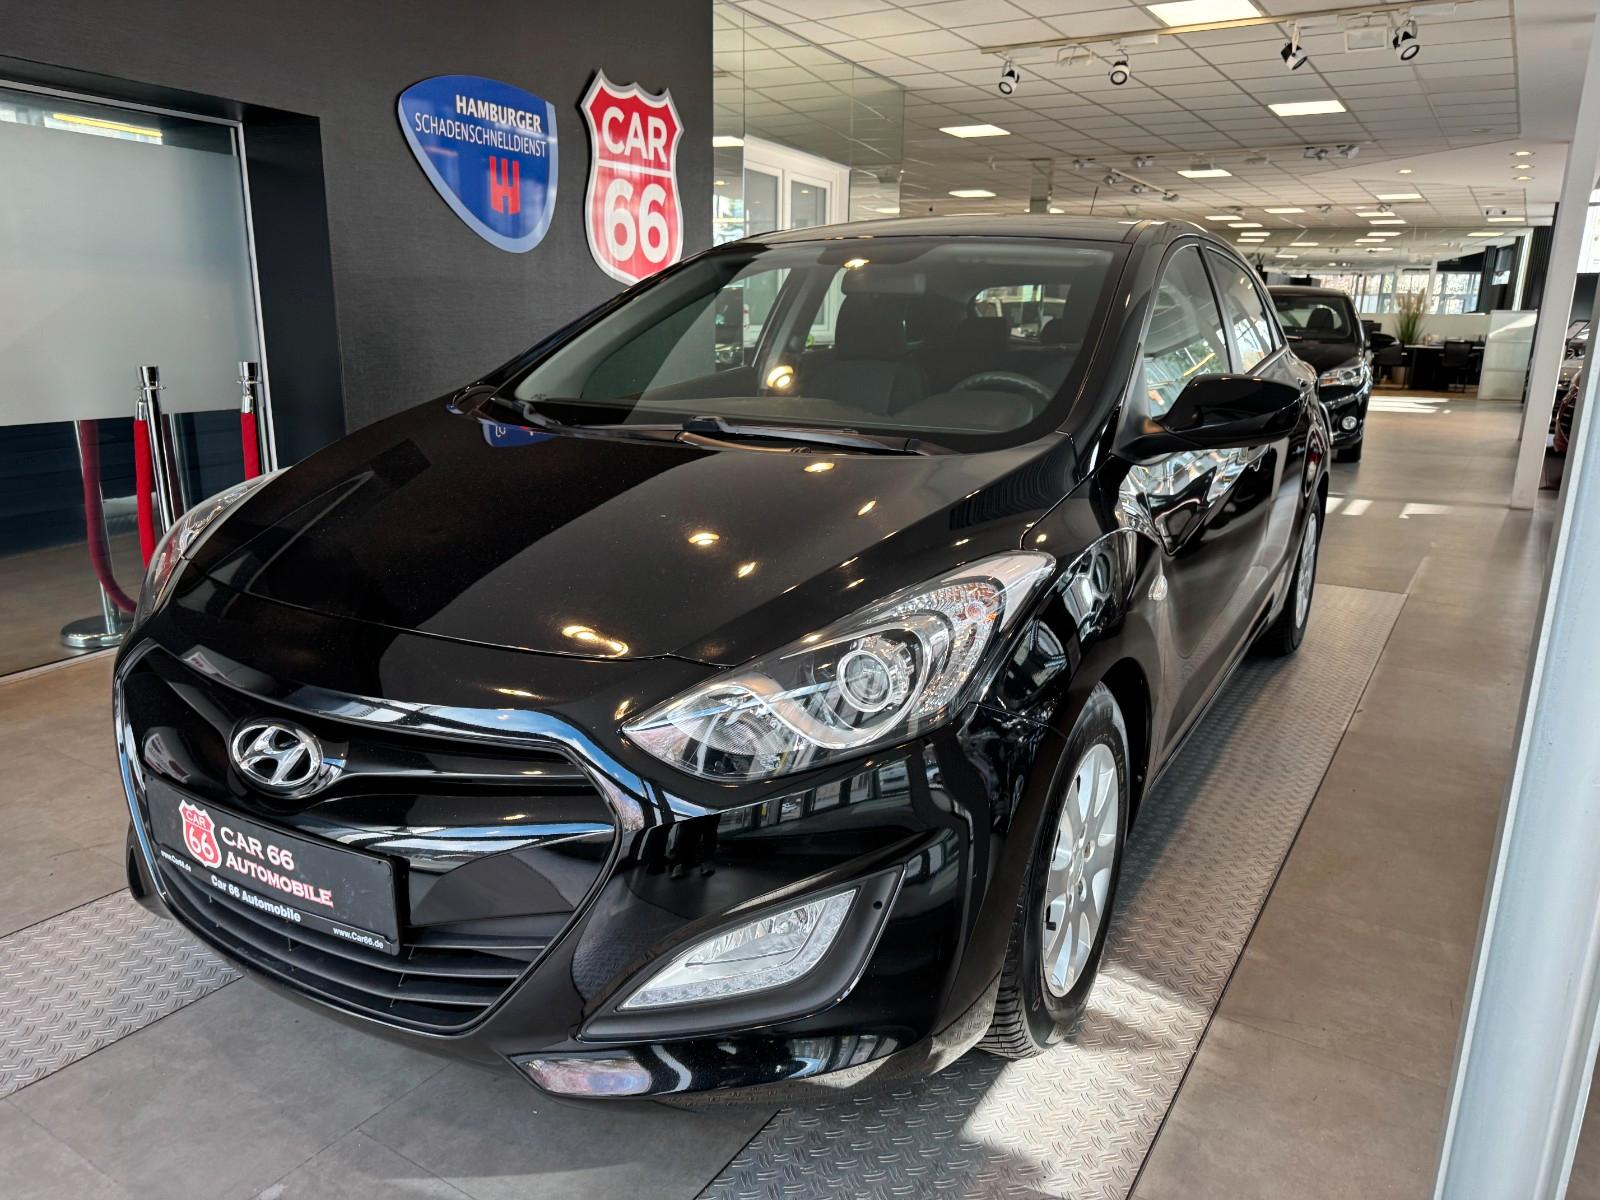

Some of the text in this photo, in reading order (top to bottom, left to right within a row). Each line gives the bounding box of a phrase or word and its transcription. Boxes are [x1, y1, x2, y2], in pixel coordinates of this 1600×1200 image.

[415, 112, 547, 158] SCHADENSCHNELLDIENST
[455, 94, 542, 133] HAMBURGER
[602, 106, 668, 164] CAR
[604, 178, 669, 264] 66
[185, 809, 205, 828] CAR
[188, 828, 214, 861] 66
[220, 826, 295, 871] CAR 66
[211, 874, 301, 922] Car 66 Automobile
[225, 851, 334, 908] AUTOMOBILE
[332, 926, 384, 949] www.Car66.de
